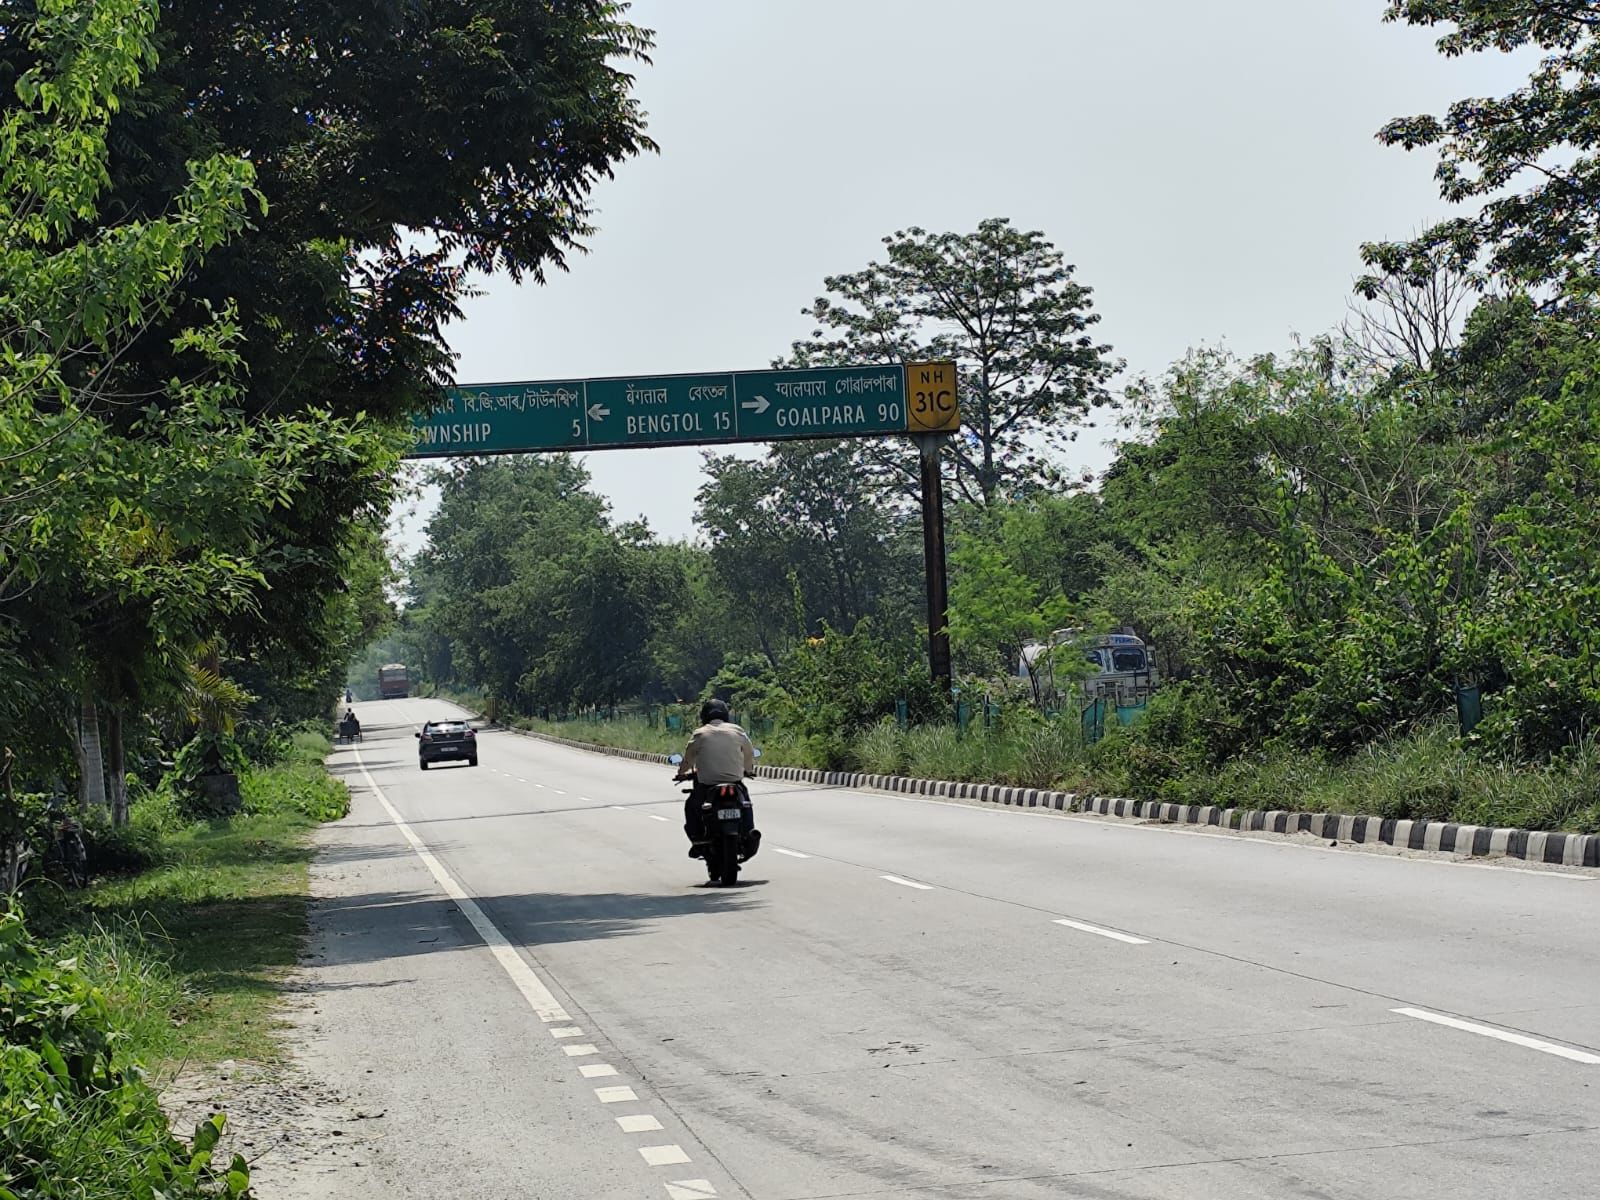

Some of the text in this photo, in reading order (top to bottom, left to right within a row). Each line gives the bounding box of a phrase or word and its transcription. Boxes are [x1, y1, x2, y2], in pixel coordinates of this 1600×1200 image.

[775, 380, 826, 397] ग्वालपारा
[921, 370, 944, 384] NH
[689, 385, 728, 401] বেংতল
[915, 390, 952, 413] 31C
[627, 411, 731, 435] BENGTOL 15
[776, 403, 900, 427] GOALPARA 90
[409, 419, 581, 446] OWNSHIP 5
